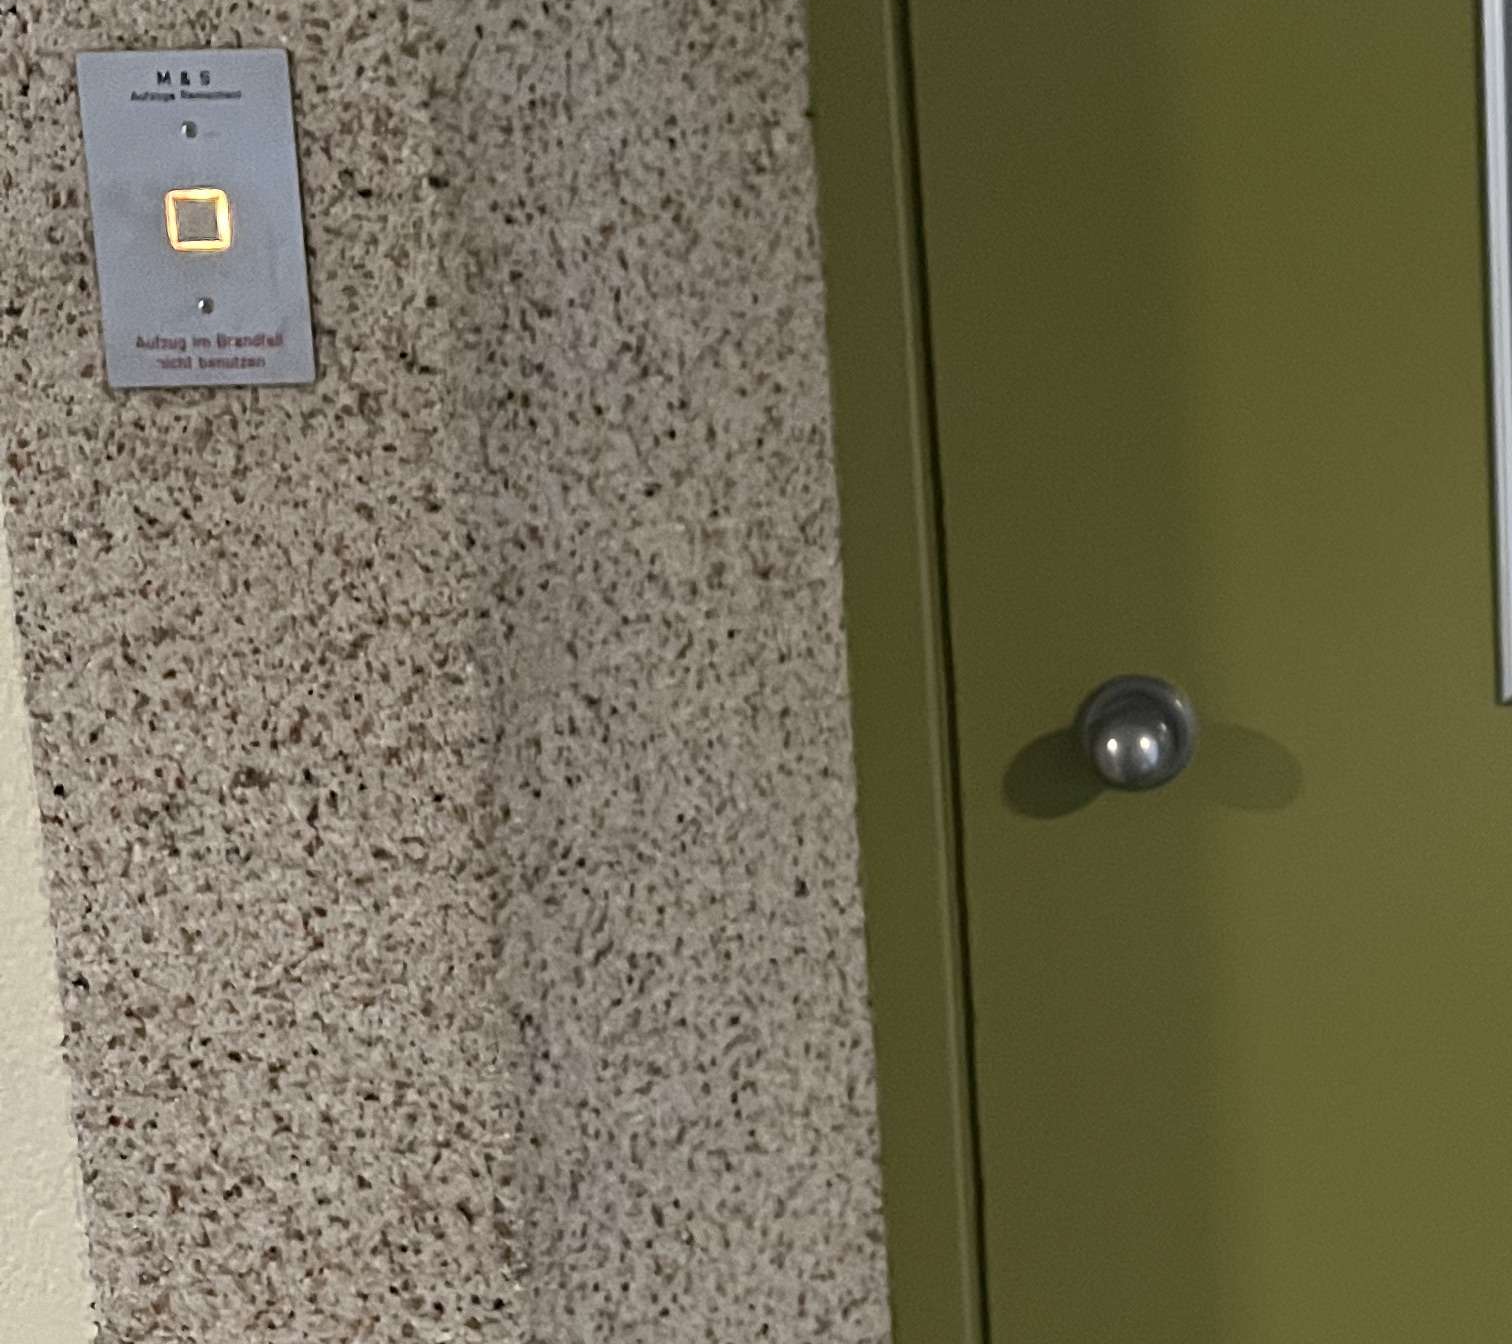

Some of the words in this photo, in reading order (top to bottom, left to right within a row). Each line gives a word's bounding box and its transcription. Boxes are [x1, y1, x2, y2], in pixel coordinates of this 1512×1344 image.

[157, 71, 171, 85] M
[180, 71, 190, 85] &
[200, 70, 210, 85] S
[136, 336, 187, 352] Aufzug
[192, 337, 211, 348] im
[216, 333, 283, 348] Brandfall
[199, 356, 265, 368] benutzen
